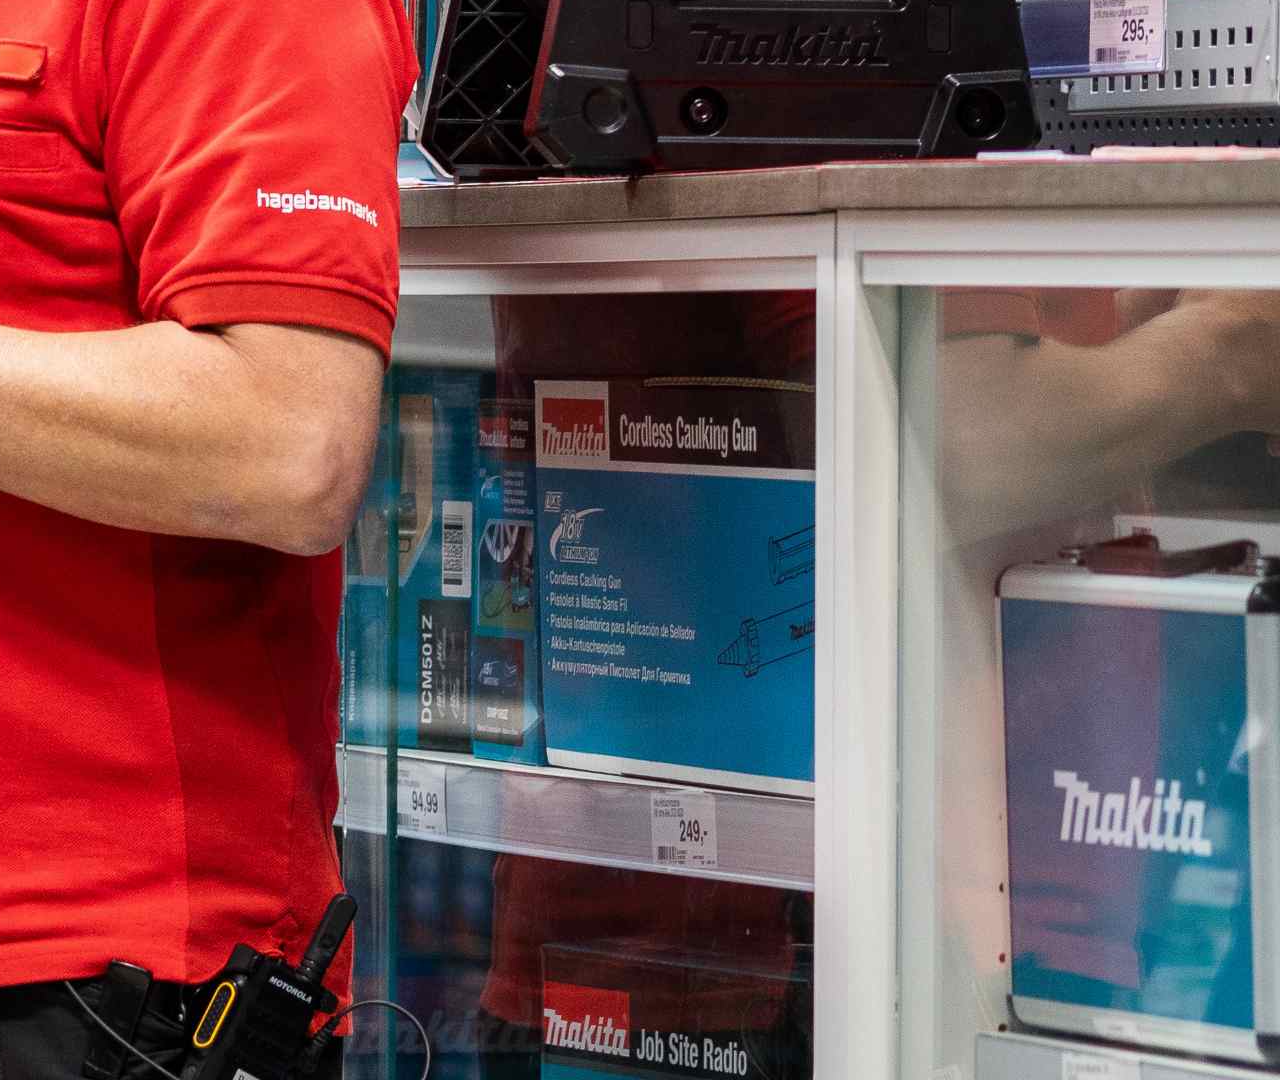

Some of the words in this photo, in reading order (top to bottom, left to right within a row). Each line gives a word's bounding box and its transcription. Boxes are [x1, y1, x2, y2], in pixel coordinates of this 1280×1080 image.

[689, 21, 890, 67] Makita
[1122, 19, 1153, 45] 295,-
[256, 187, 378, 227] hagebaumarkt
[542, 416, 609, 457] Makita
[620, 414, 673, 449] Cordless
[676, 415, 728, 457] Caulking
[732, 417, 757, 452] Gun
[549, 571, 578, 586] Cordless
[580, 572, 607, 591] Caulking
[608, 575, 622, 589] Gun
[420, 613, 433, 724] DCM501Z
[412, 790, 438, 816] 94,99
[1053, 770, 1213, 858] Makita
[680, 819, 707, 847] 249,-
[268, 976, 313, 1004] MOTOROLA
[544, 1008, 630, 1057] Makita
[636, 1029, 664, 1063] Job
[668, 1032, 699, 1068] Site
[703, 1038, 748, 1076] Radio
